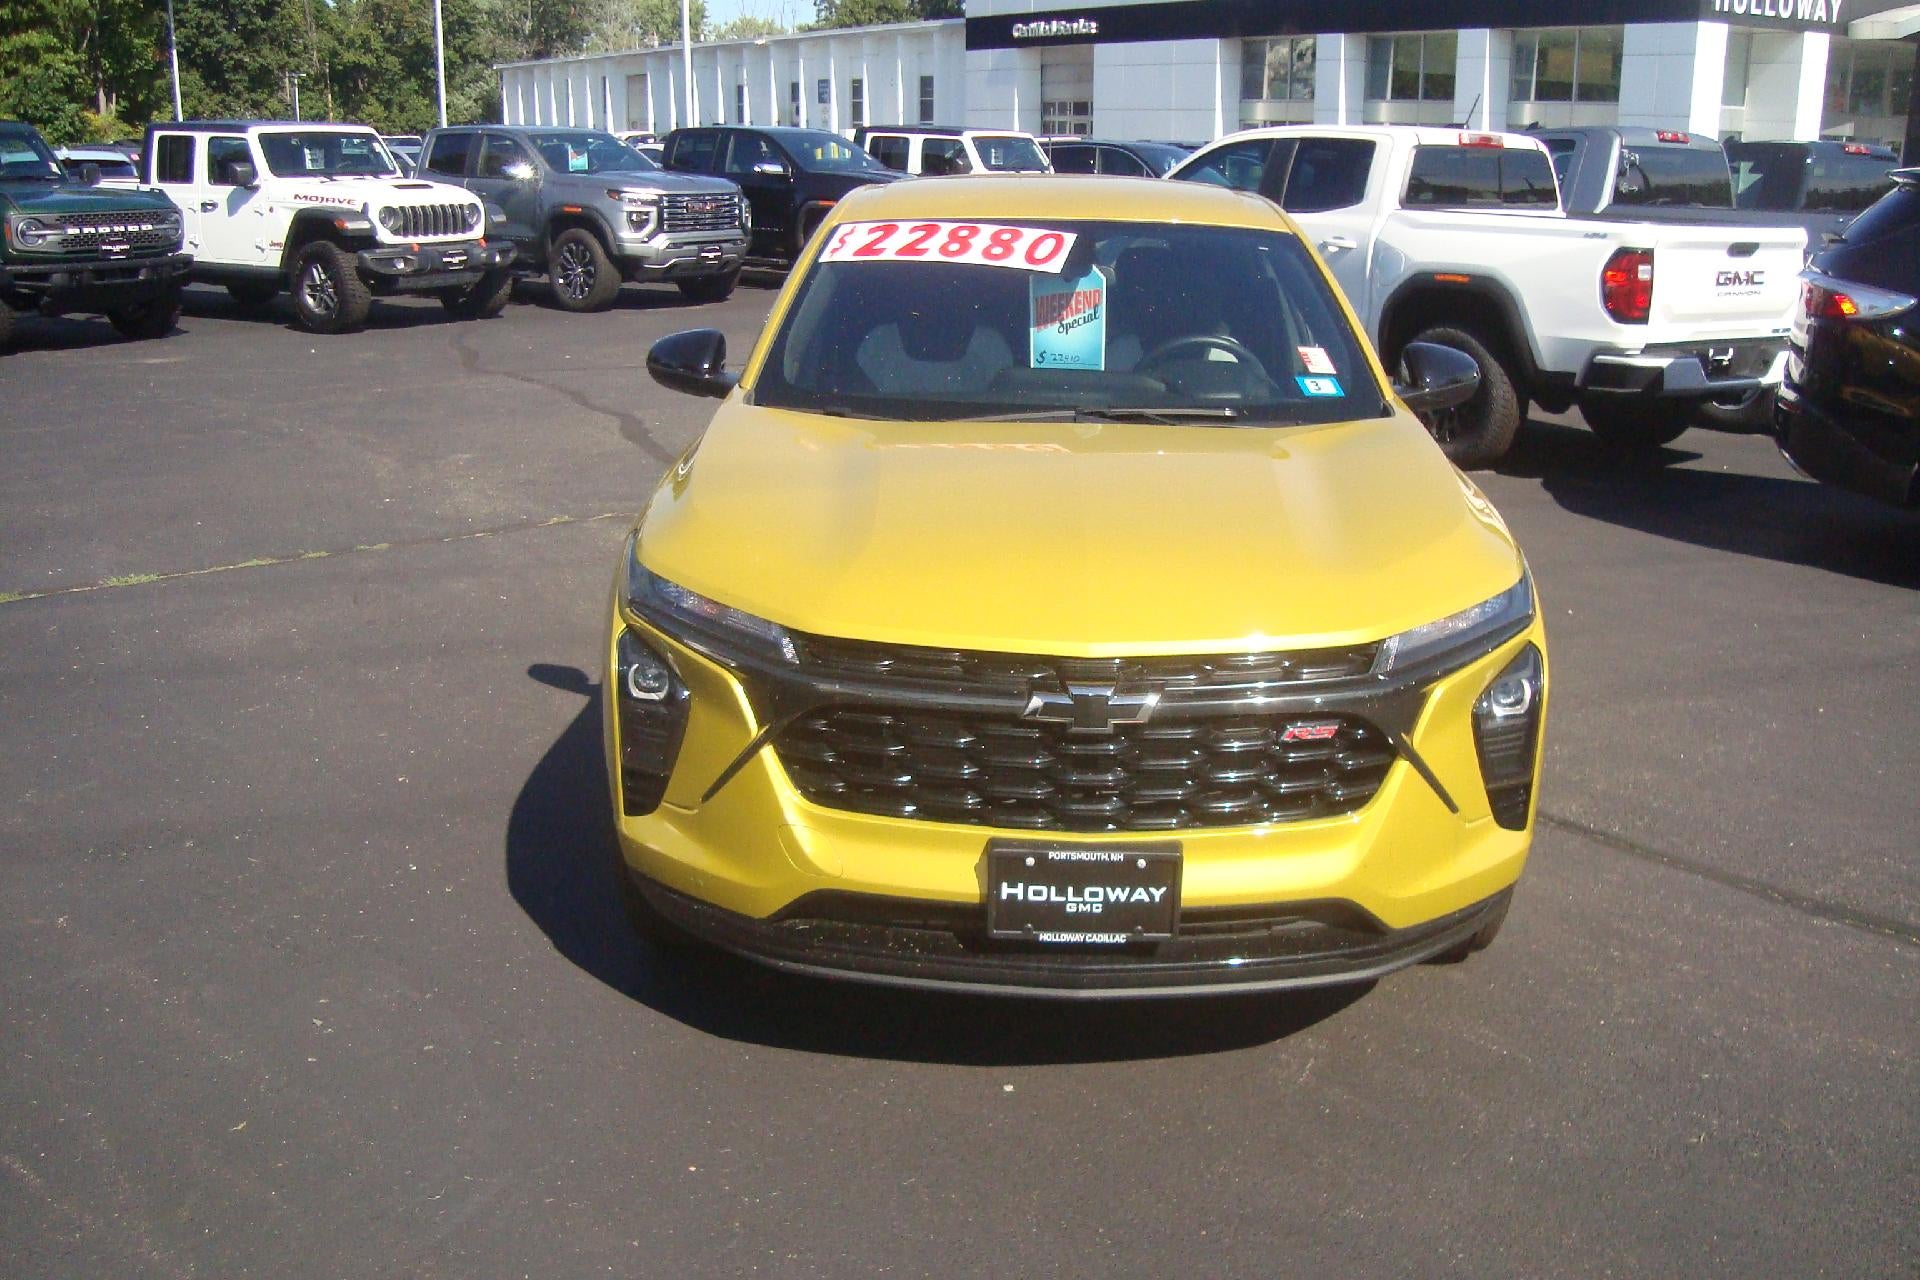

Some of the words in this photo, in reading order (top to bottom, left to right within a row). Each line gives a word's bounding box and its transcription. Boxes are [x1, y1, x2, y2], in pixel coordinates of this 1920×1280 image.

[293, 193, 357, 205] MOJAVE
[66, 224, 153, 235] BRONCO
[1716, 271, 1765, 286] GMC
[1034, 288, 1102, 332] WEEKEND
[1057, 304, 1099, 335] Special
[1281, 723, 1339, 741] RS
[1110, 852, 1124, 862] NH
[1001, 881, 1168, 903] HOLLOWAY
[1066, 903, 1103, 913] GMC
[1039, 932, 1085, 942] HOLLOWAY
[1085, 934, 1127, 943] CADILLAC
